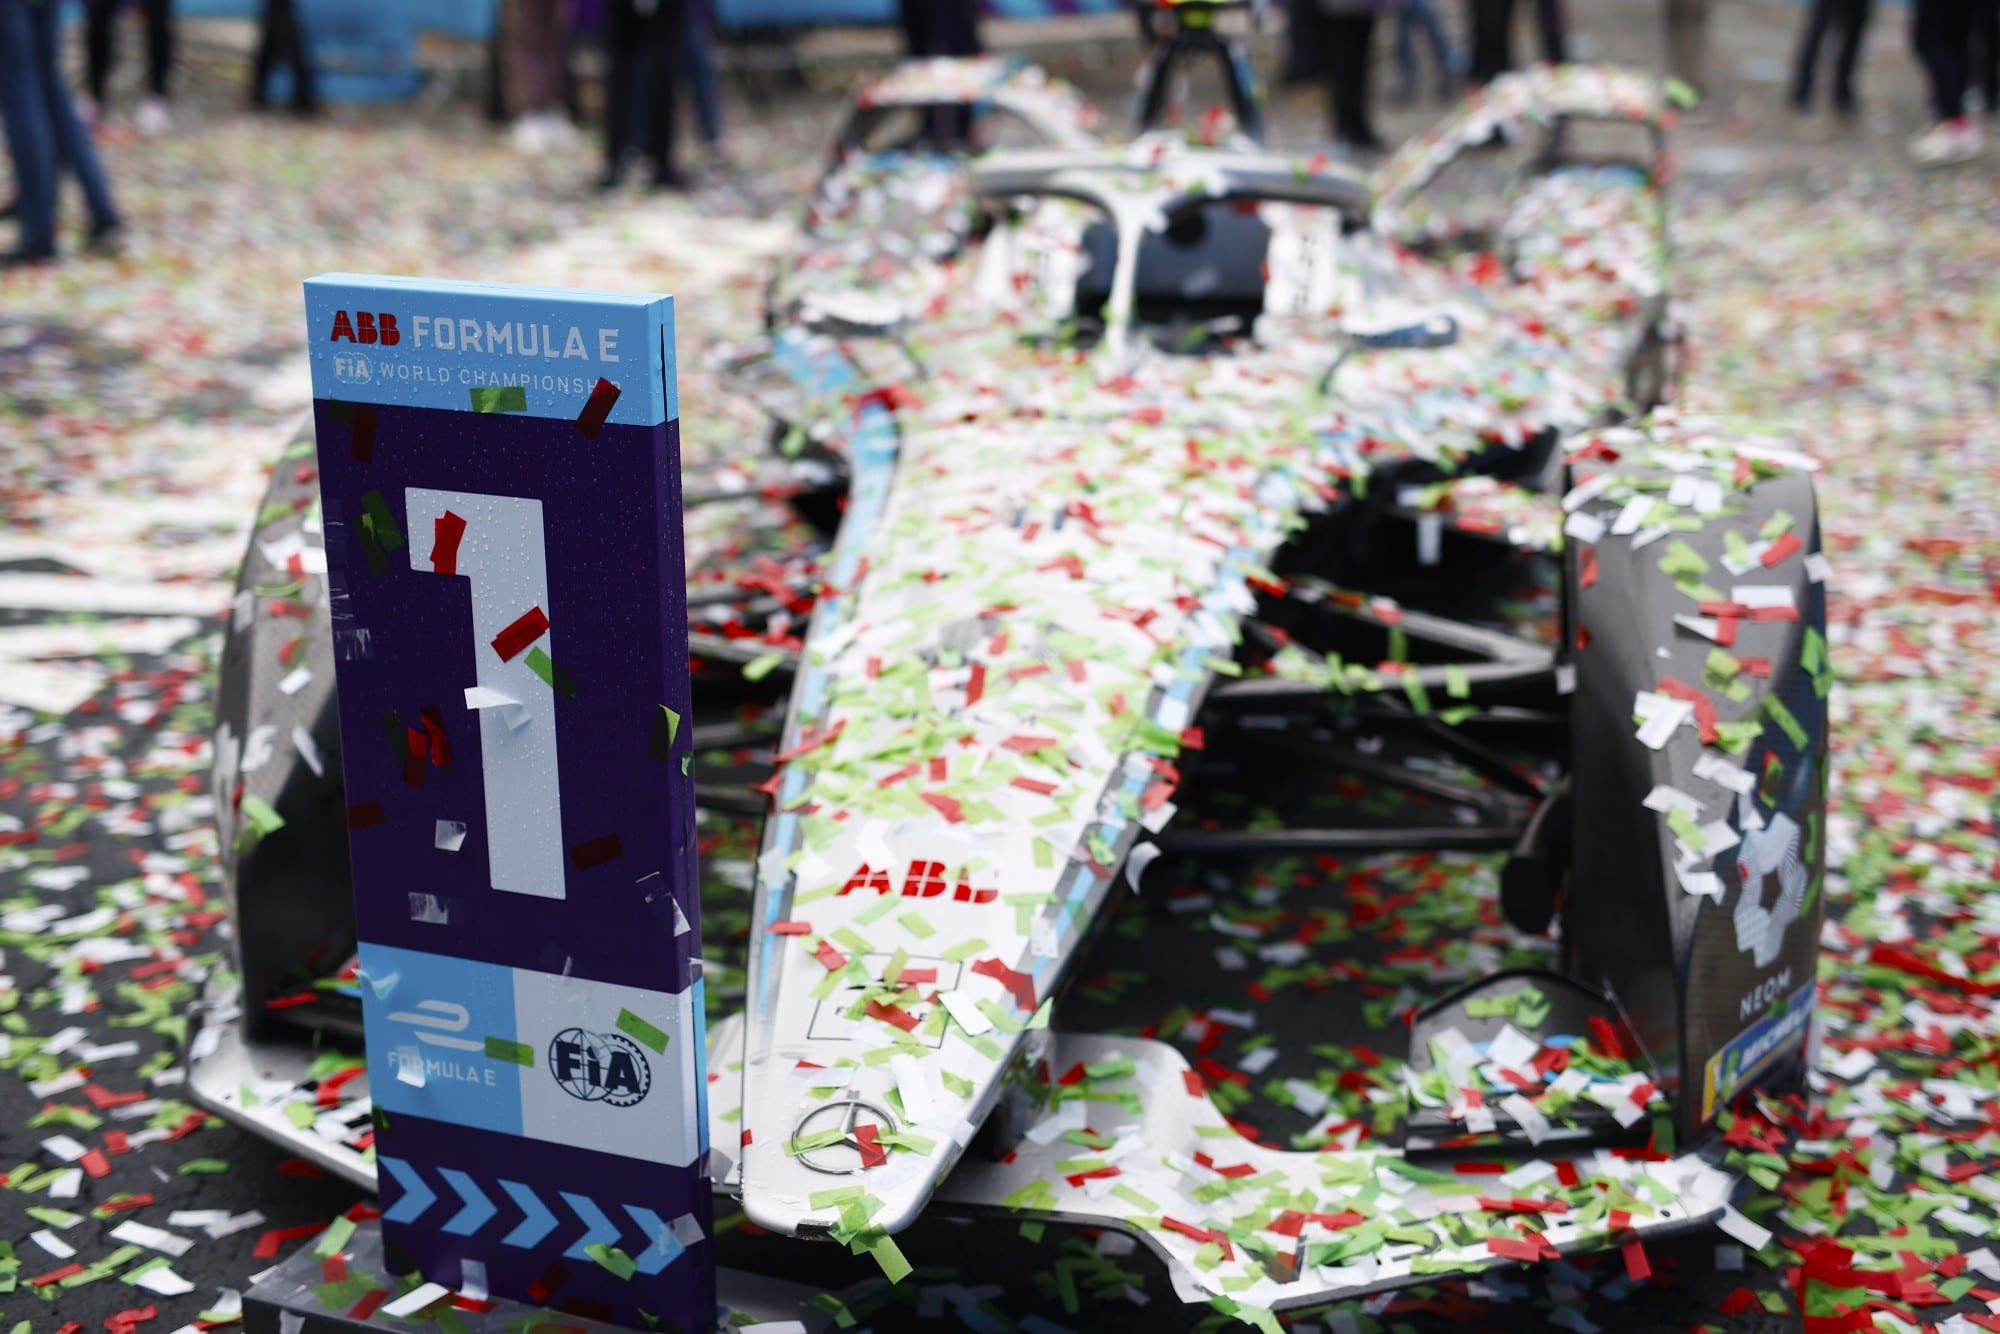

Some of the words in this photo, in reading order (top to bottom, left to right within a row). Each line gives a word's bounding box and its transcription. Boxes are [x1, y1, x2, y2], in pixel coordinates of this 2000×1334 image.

[330, 310, 400, 346] ABB
[413, 315, 589, 361] FORMULA
[598, 328, 620, 363] E
[380, 362, 450, 382] WORLD
[459, 369, 621, 396] CHAMPIONSHP
[405, 487, 566, 900] 1
[1739, 965, 1792, 1021] NEOM
[388, 1051, 480, 1083] FORMULA
[485, 1068, 496, 1087] E
